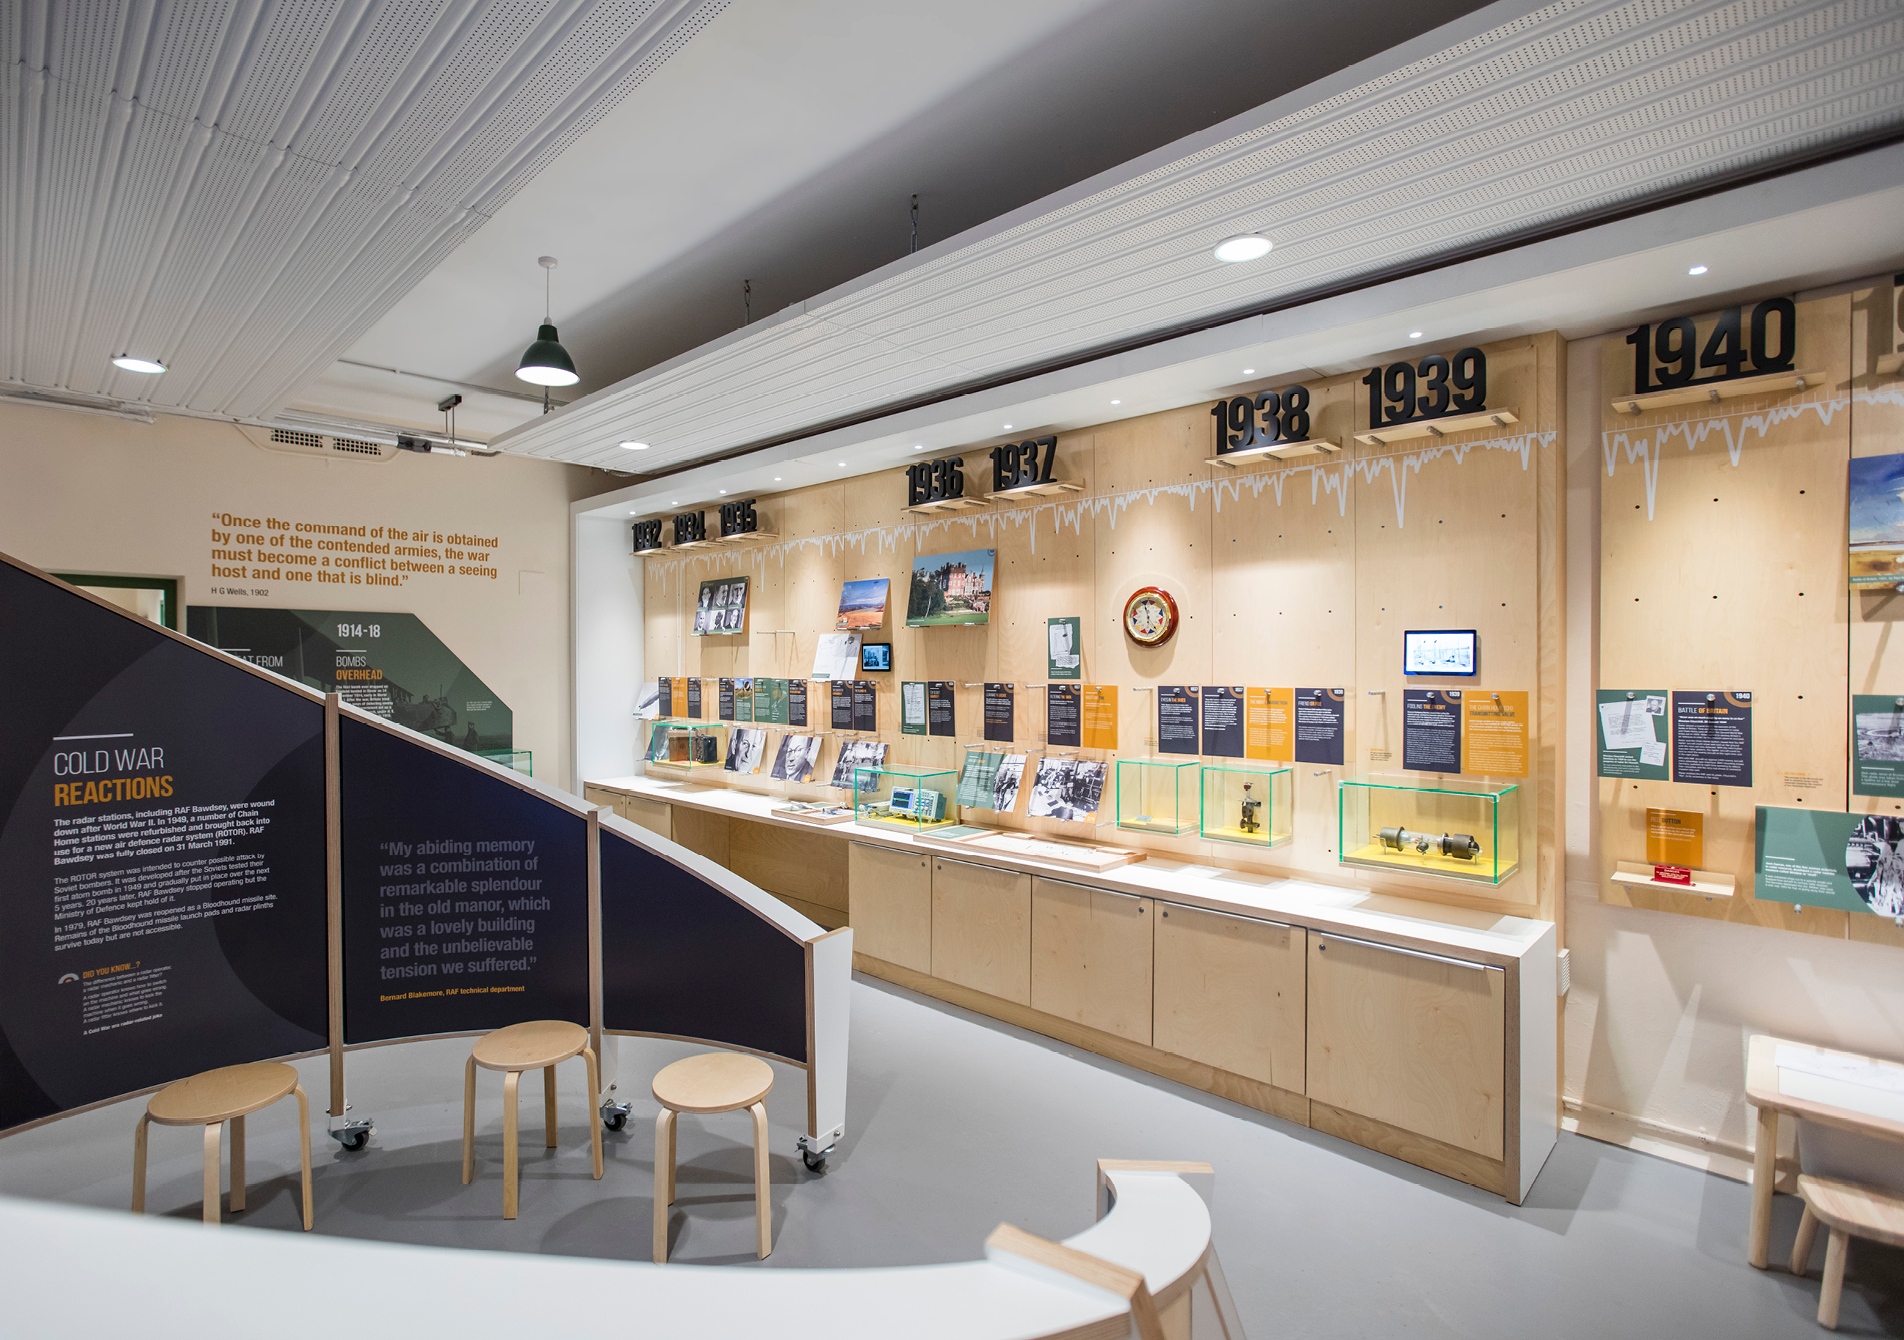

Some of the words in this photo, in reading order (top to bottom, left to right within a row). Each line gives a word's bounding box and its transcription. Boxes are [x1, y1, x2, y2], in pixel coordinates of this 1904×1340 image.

[1626, 297, 1796, 394] 1940
[1362, 347, 1487, 429] 1939
[1211, 385, 1310, 455] 1938
[990, 436, 1057, 492] 1937
[906, 457, 964, 506] 1936
[212, 513, 261, 528] “Once
[266, 517, 290, 530] the
[295, 522, 365, 537] command
[370, 526, 383, 538] of
[387, 527, 408, 540] the
[412, 530, 429, 542] air
[433, 531, 443, 543] is
[447, 533, 497, 547] obtained
[672, 510, 706, 545] 1934
[719, 499, 757, 537] 1935
[212, 529, 230, 545] by
[236, 533, 264, 545] one
[270, 534, 284, 546] of
[289, 535, 312, 549] the
[317, 539, 390, 554] contended
[394, 545, 441, 560] armies,
[445, 547, 463, 560] the
[467, 551, 489, 561] war
[632, 519, 662, 552] 1932
[212, 550, 252, 561] must
[258, 550, 316, 565] become
[321, 556, 329, 566] a
[334, 556, 386, 570] conflict
[390, 558, 444, 573] between
[448, 565, 455, 574] a
[459, 564, 497, 579] seeing
[212, 564, 246, 578] host
[252, 567, 280, 580] and
[286, 570, 312, 581] one
[317, 570, 345, 583] that
[350, 571, 361, 584] is
[366, 572, 408, 586] blind.”
[226, 587, 248, 596] Wells,
[337, 623, 381, 638] 1914-18
[256, 655, 283, 667] FROM
[336, 656, 366, 667] BOMBS
[336, 669, 383, 680] OVERHEAD
[54, 750, 109, 776] COLD
[115, 747, 164, 771] WAR
[54, 775, 174, 807] REACTIONS
[53, 818, 70, 826] The
[72, 816, 96, 824] radar
[97, 813, 133, 822] stations,
[135, 809, 172, 818] including
[174, 806, 190, 814] RAF
[192, 804, 228, 814] Bawdsey,
[250, 799, 274, 807] wound
[53, 828, 78, 836] down
[80, 825, 101, 833] after
[103, 822, 127, 830] World
[129, 820, 146, 828] War
[167, 816, 188, 826] 1949,
[197, 813, 226, 821] number
[53, 837, 79, 846] Home
[81, 834, 116, 843] stations
[140, 825, 186, 836] refurbished
[188, 823, 203, 831] and
[204, 820, 234, 831] brought
[236, 818, 254, 826] back
[72, 846, 85, 854] for
[94, 843, 113, 851] new
[127, 838, 160, 847] defence
[162, 835, 183, 843] radar
[185, 832, 213, 842] system
[215, 828, 247, 837] (ROTOR).
[249, 826, 264, 834] RAF
[54, 854, 94, 865] Bawdsey
[116, 849, 134, 857] fully
[136, 845, 162, 855] closed
[188, 840, 212, 849] March
[214, 838, 234, 846] 1991.
[380, 841, 412, 857] “My
[416, 840, 471, 855] abiding
[476, 840, 534, 854] memory
[70, 873, 97, 882] ROTOR
[98, 870, 124, 879] system
[142, 864, 172, 872] intended
[208, 856, 234, 865] possible
[379, 864, 412, 876] was
[416, 863, 425, 874] a
[430, 858, 520, 873] combination
[524, 856, 538, 870] of
[380, 880, 467, 897] remarkable
[471, 877, 542, 894] splendour
[380, 903, 394, 917] in
[399, 902, 423, 916] the
[427, 900, 450, 914] old
[455, 901, 504, 913] manor,
[507, 896, 550, 910] which
[380, 925, 412, 938] was
[417, 924, 425, 935] a
[431, 920, 473, 935] lovely
[478, 917, 534, 933] building
[380, 944, 409, 959] and
[413, 943, 438, 955] the
[442, 937, 533, 954] unbelievable
[83, 970, 95, 979] DID
[96, 967, 110, 976] YOU
[380, 964, 436, 979] tension
[441, 963, 463, 974] we
[467, 956, 536, 972] suffered.”
[380, 992, 406, 1001] Bernard
[489, 985, 524, 993] department
